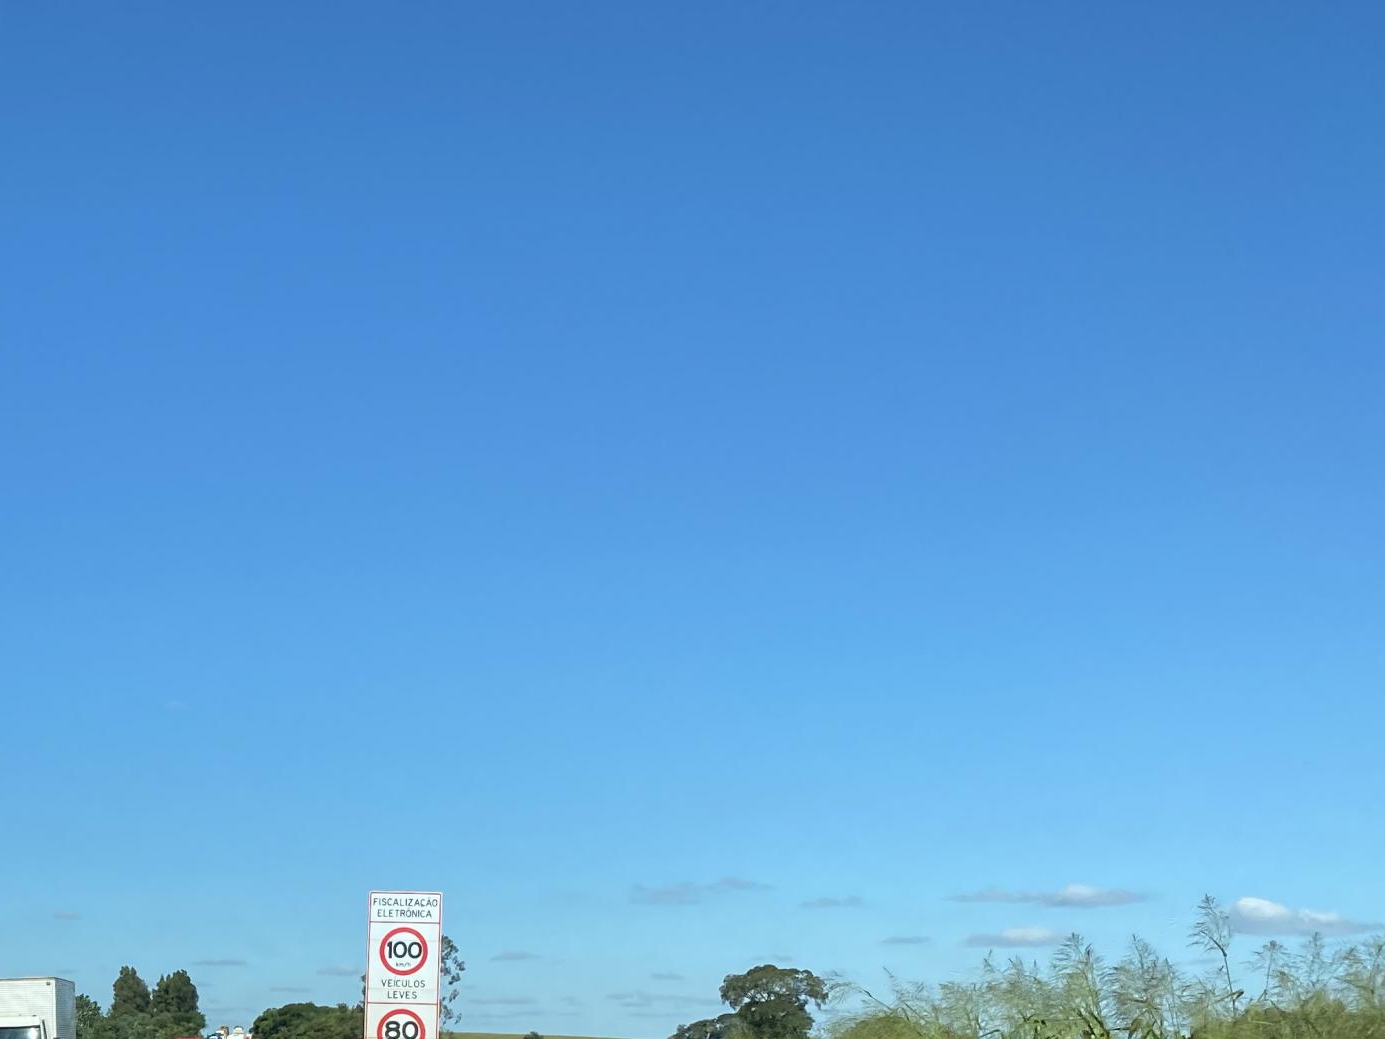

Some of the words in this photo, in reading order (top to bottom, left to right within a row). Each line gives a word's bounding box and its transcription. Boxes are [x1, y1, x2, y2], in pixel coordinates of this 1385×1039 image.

[373, 897, 438, 907] FISCALIZAÇÃO
[377, 908, 432, 918] ELETRÔNICA
[387, 941, 422, 959] 100
[381, 977, 425, 988] VEÍCULOS
[387, 990, 418, 1000] LEVES
[385, 1020, 419, 1039] 80
